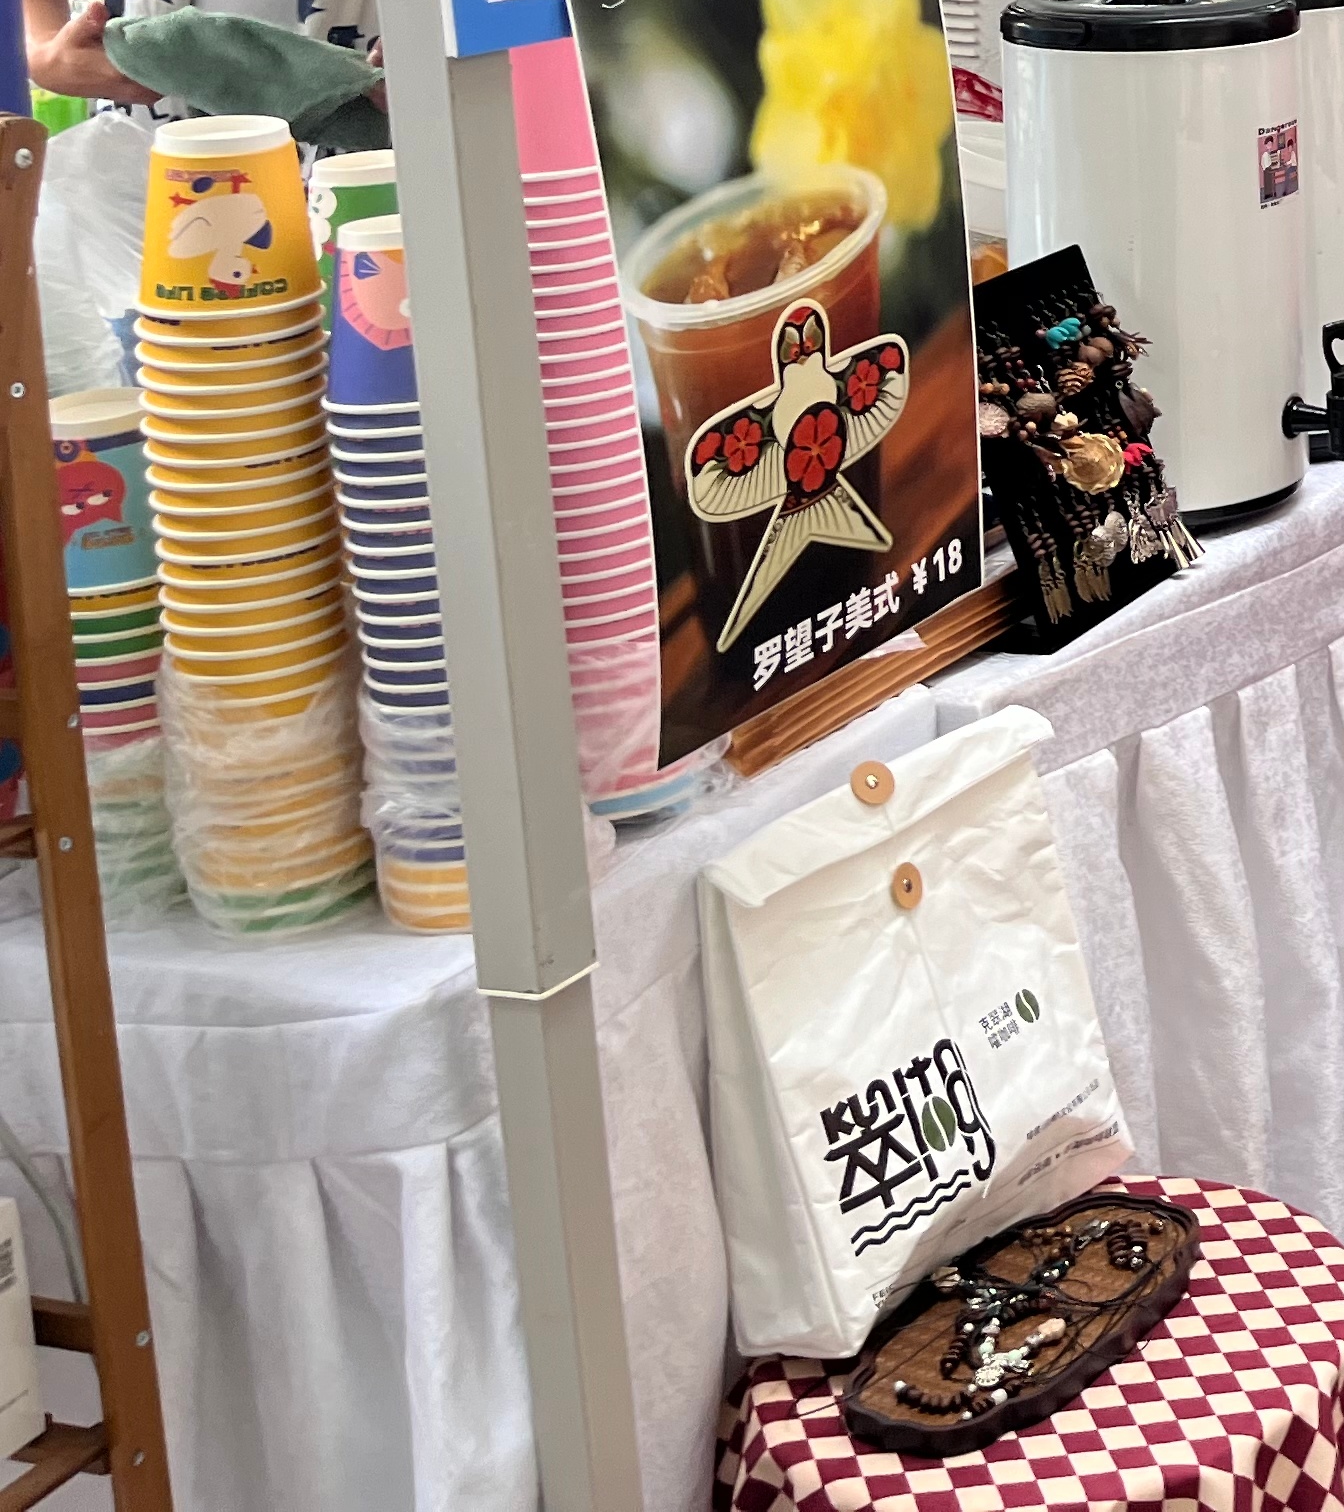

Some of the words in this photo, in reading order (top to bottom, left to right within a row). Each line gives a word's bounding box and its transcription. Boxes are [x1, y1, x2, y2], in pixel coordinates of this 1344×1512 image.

[752, 572, 900, 691] 罗望子美式
[912, 537, 965, 597] ¥18
